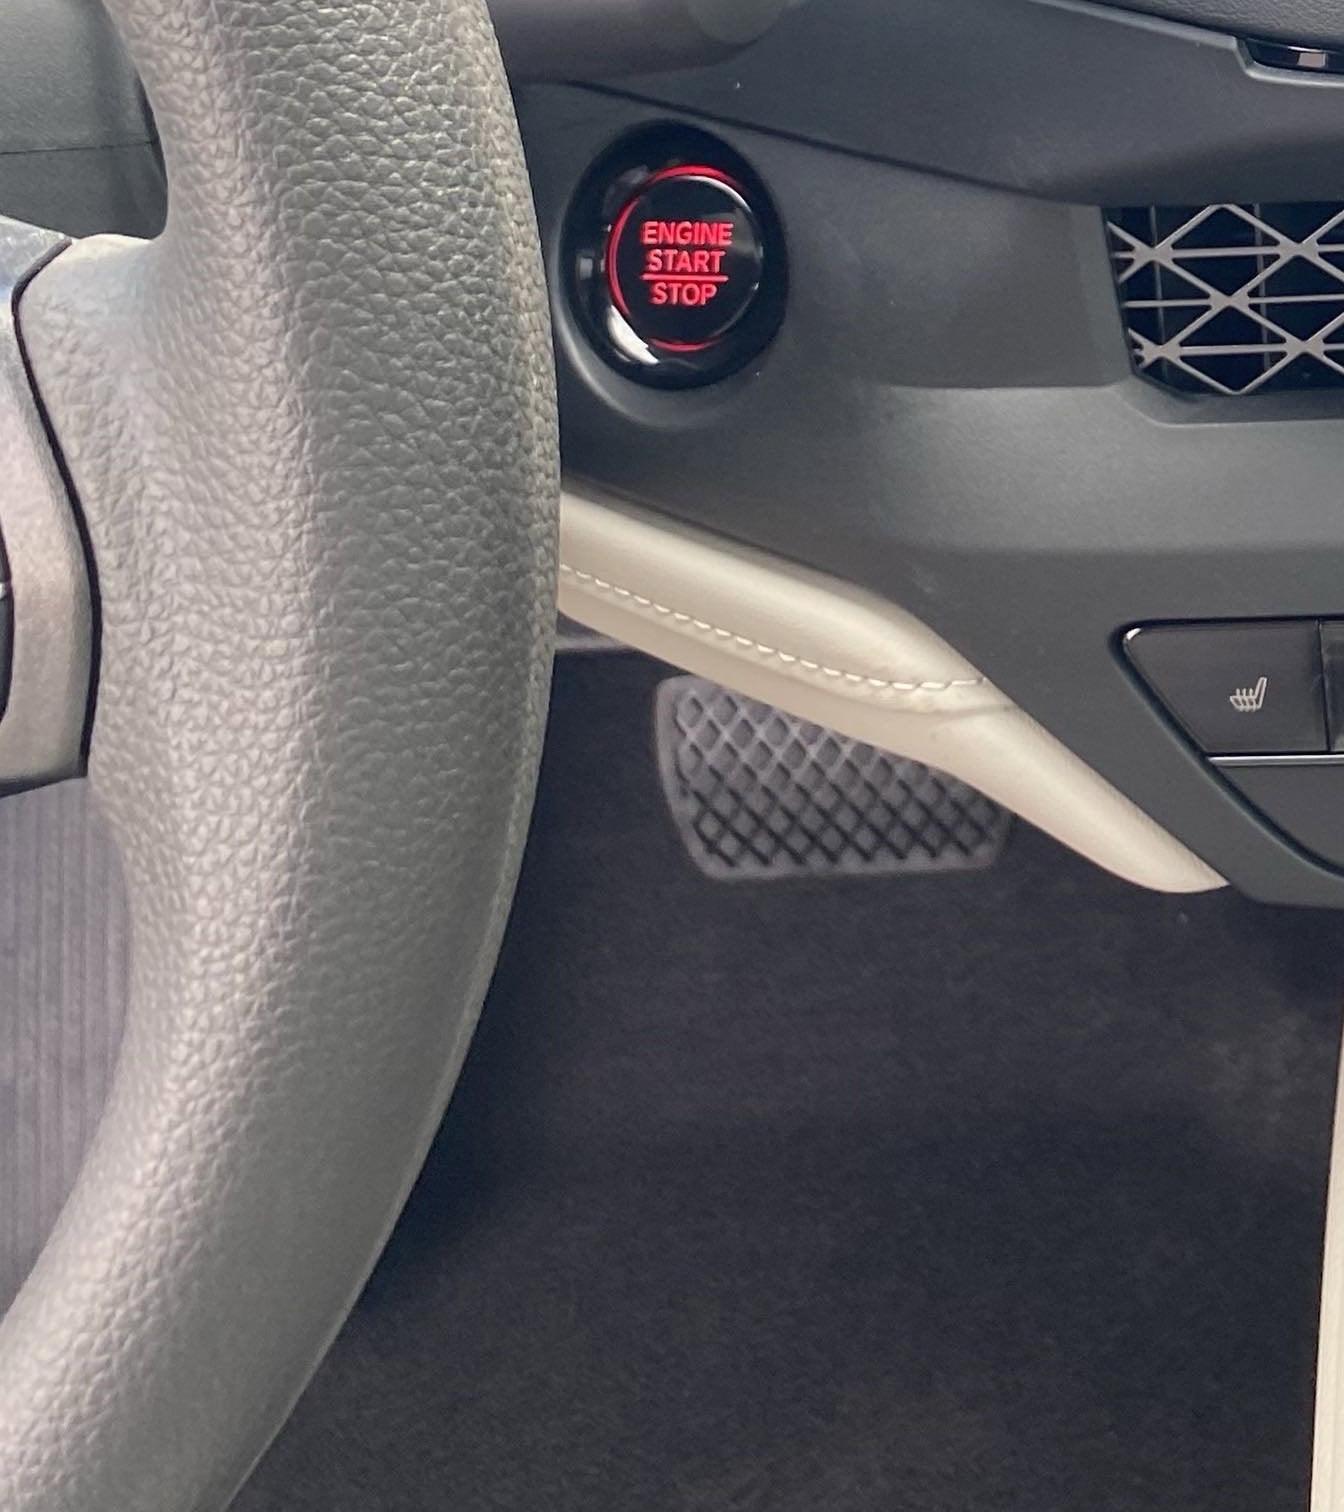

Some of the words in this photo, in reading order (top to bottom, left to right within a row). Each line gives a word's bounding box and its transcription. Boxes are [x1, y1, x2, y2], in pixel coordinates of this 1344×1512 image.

[641, 221, 734, 246] ENGINE
[646, 249, 726, 273] START
[651, 282, 718, 305] STOP
